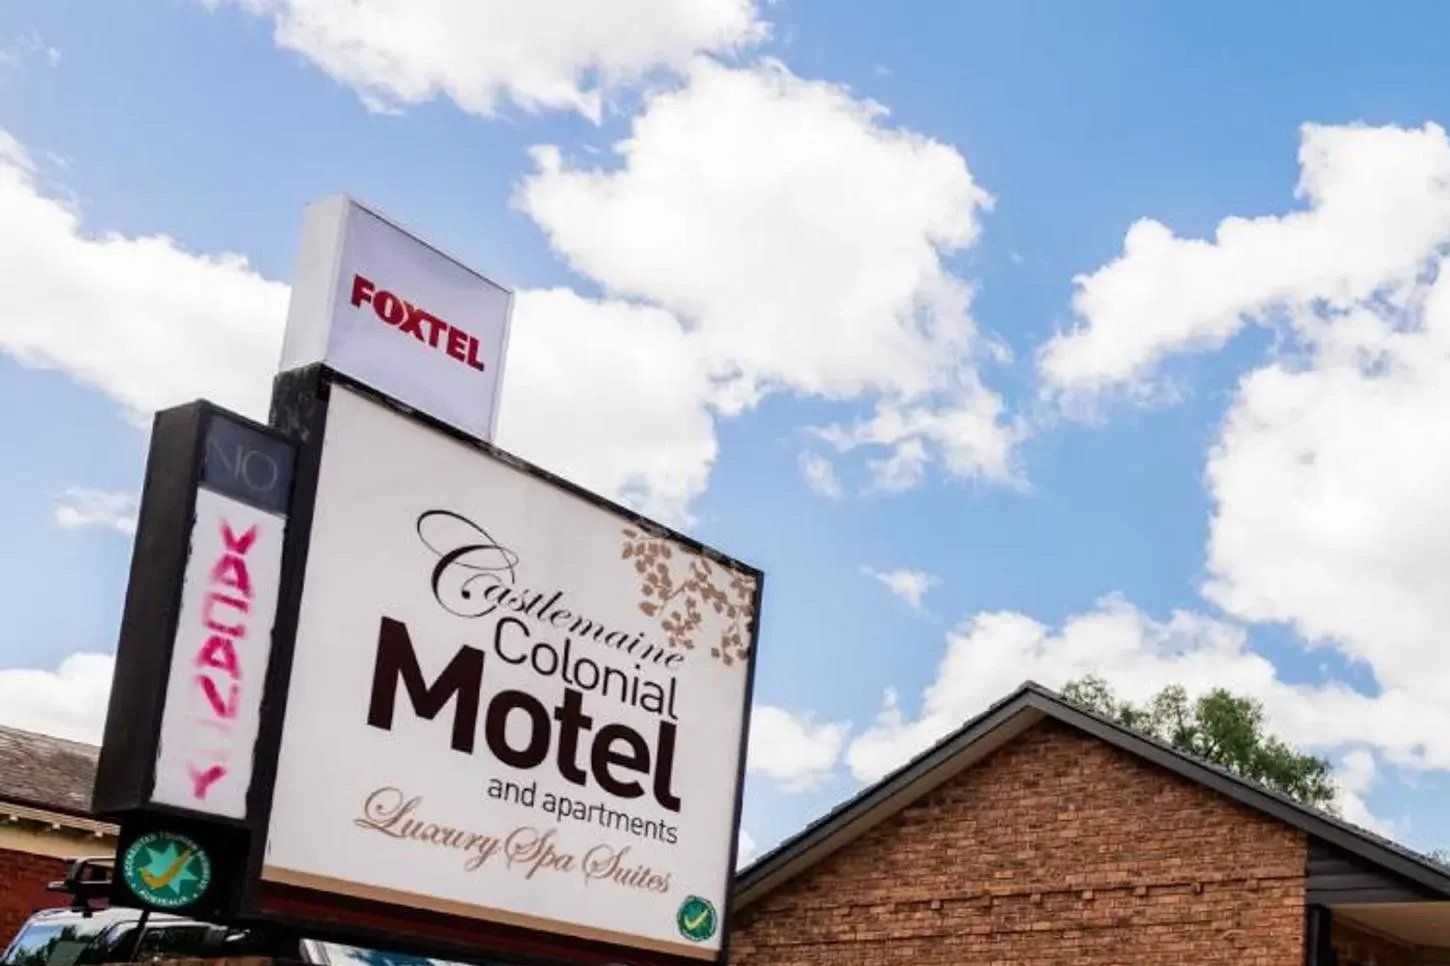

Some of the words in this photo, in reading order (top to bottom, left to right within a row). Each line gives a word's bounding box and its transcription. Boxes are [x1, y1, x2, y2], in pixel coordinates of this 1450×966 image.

[351, 274, 484, 372] FOXTEL
[205, 440, 279, 491] NO
[417, 510, 684, 671] Castlemaine
[367, 616, 682, 813] Motel
[494, 616, 678, 720] Colonial
[354, 786, 501, 872] Luxury
[504, 825, 576, 880] Spa
[582, 844, 671, 894] Suites
[488, 777, 537, 808] and
[543, 790, 679, 845] apartments
